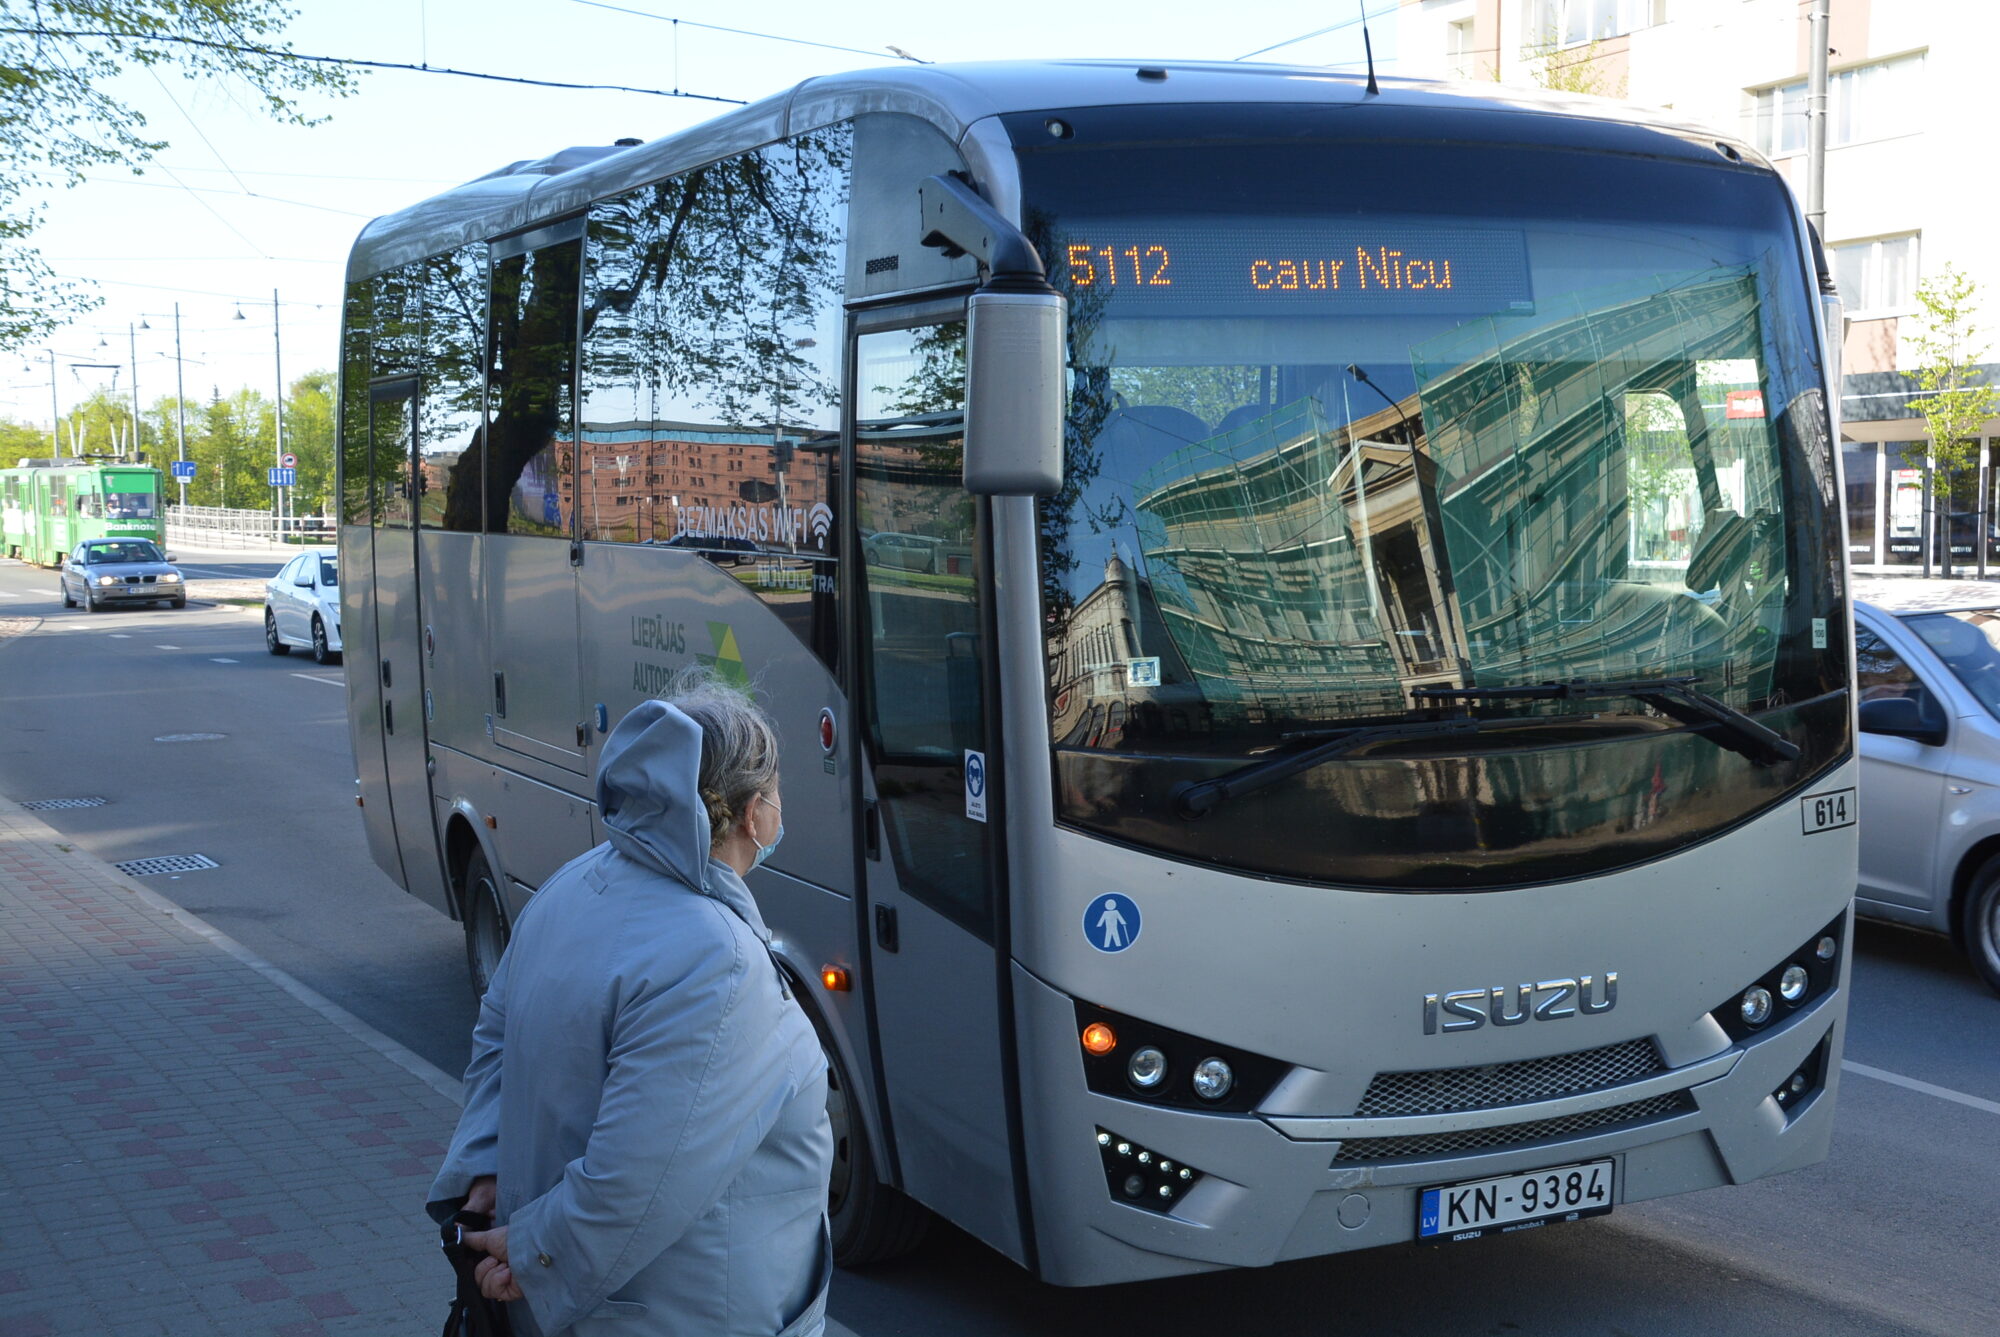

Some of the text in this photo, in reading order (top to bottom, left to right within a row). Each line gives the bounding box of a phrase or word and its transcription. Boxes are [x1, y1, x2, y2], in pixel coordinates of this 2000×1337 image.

[1068, 245, 1451, 290] 5112 caur Nīcu
[677, 506, 769, 542] BEZMAKSAS
[631, 614, 686, 654] LIEPĀJAS
[1815, 796, 1847, 827] 614
[1423, 972, 1618, 1036] ISUZU
[1447, 1168, 1605, 1227] KN-9384
[1423, 1216, 1438, 1228] LV
[1453, 1231, 1482, 1242] ISUZU
